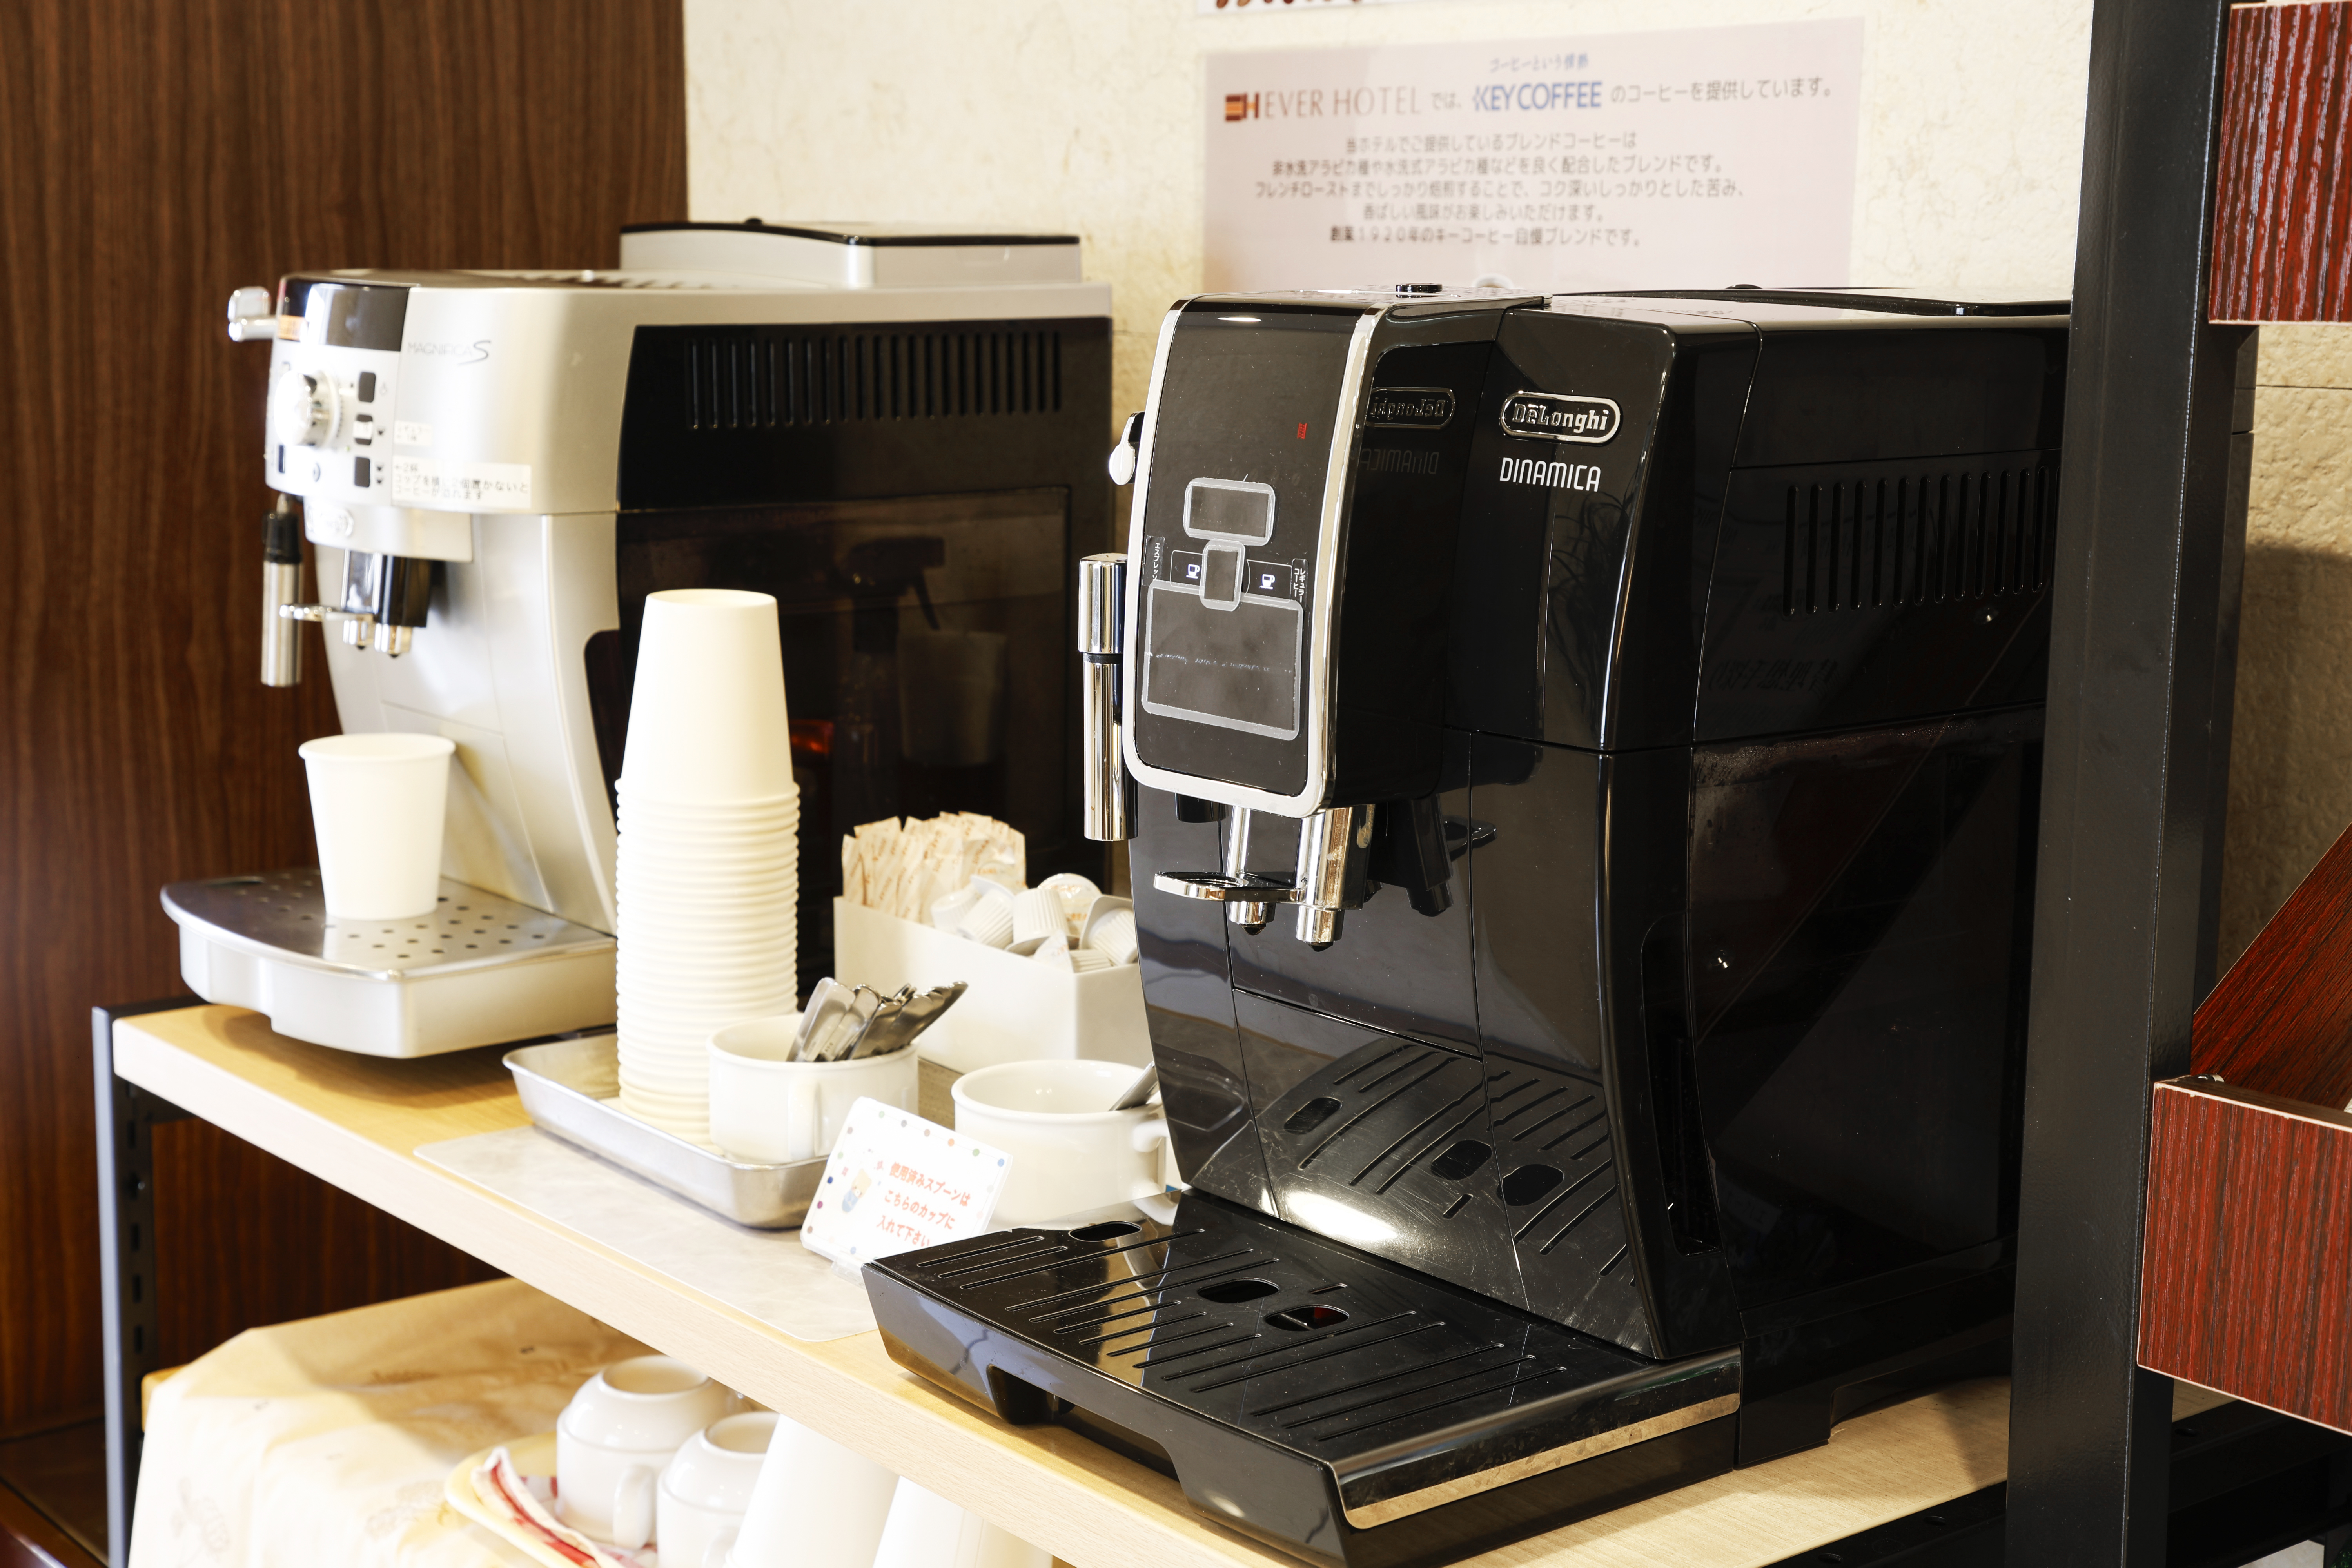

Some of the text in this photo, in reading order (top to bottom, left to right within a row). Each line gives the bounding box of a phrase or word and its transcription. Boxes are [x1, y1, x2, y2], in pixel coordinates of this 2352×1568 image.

[1333, 85, 1421, 118] HOTEL
[1500, 457, 1601, 492] DINAMICA
[889, 1161, 971, 1207] 使用済みスプーンは
[884, 1189, 956, 1230] こちらのカップに
